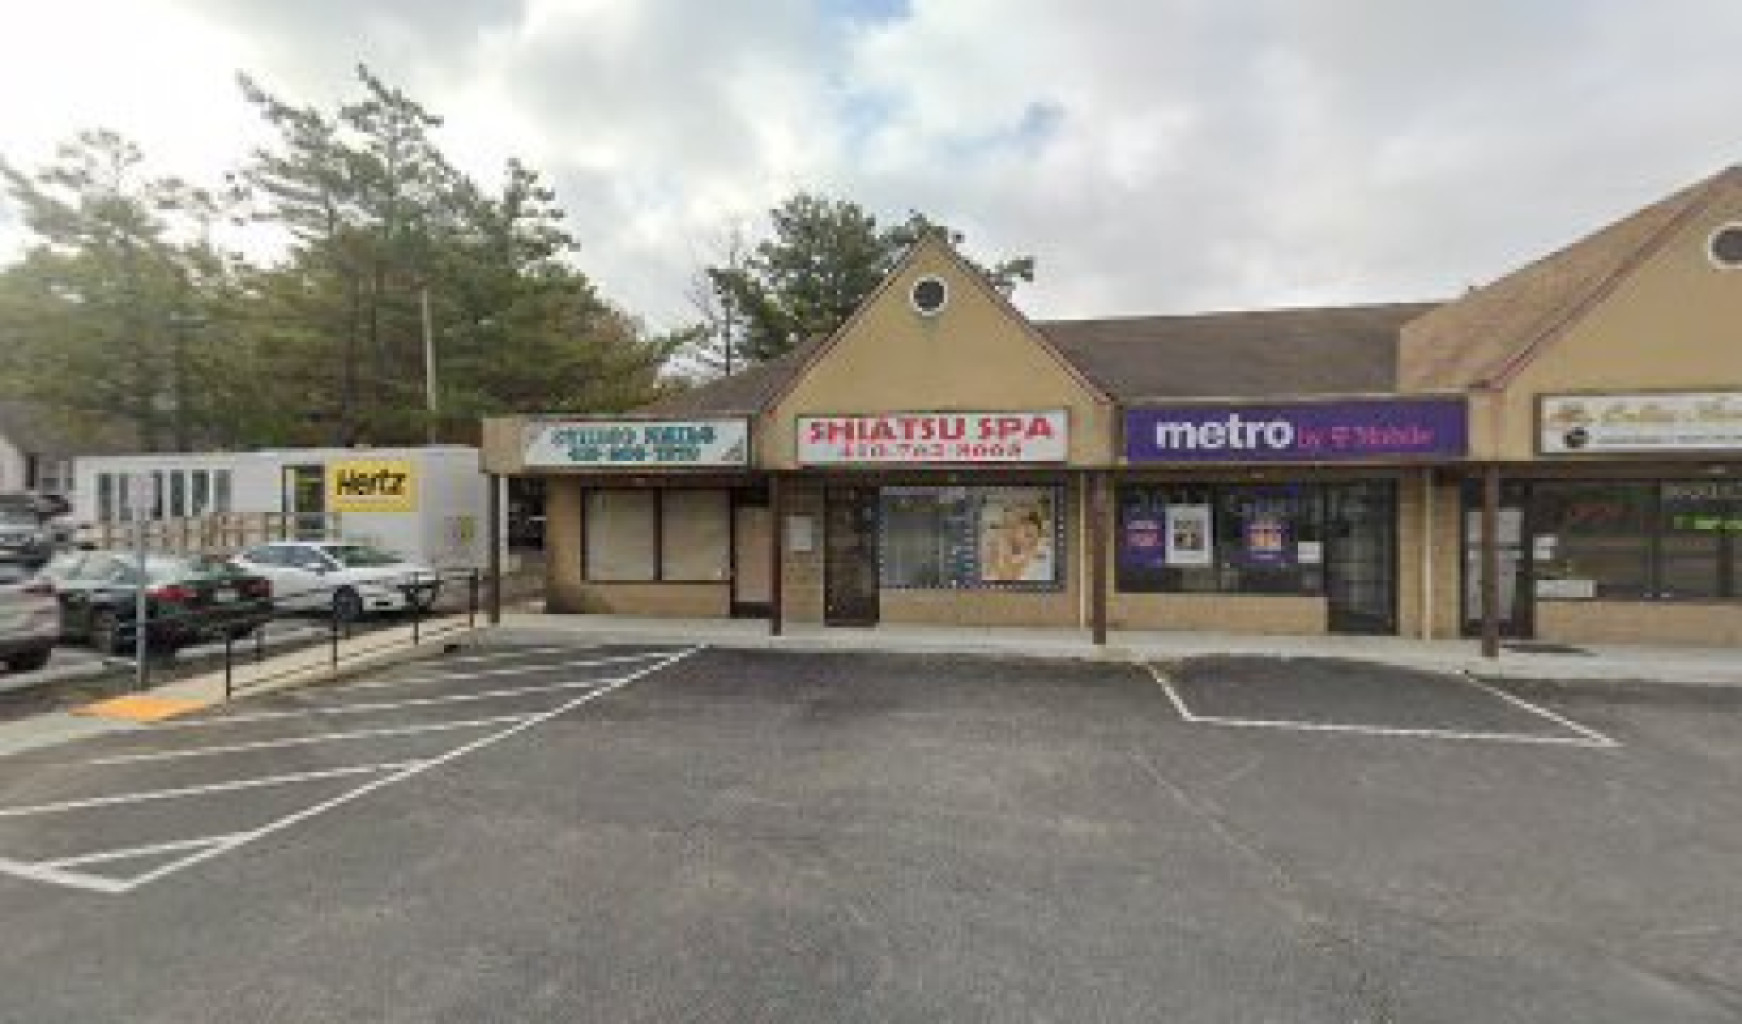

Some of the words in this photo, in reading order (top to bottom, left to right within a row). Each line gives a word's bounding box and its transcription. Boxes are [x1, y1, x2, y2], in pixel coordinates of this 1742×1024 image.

[809, 417, 966, 444] SHIATSU
[977, 416, 1055, 440] SPA
[1155, 412, 1295, 450] metro
[335, 467, 408, 496] Hertz
